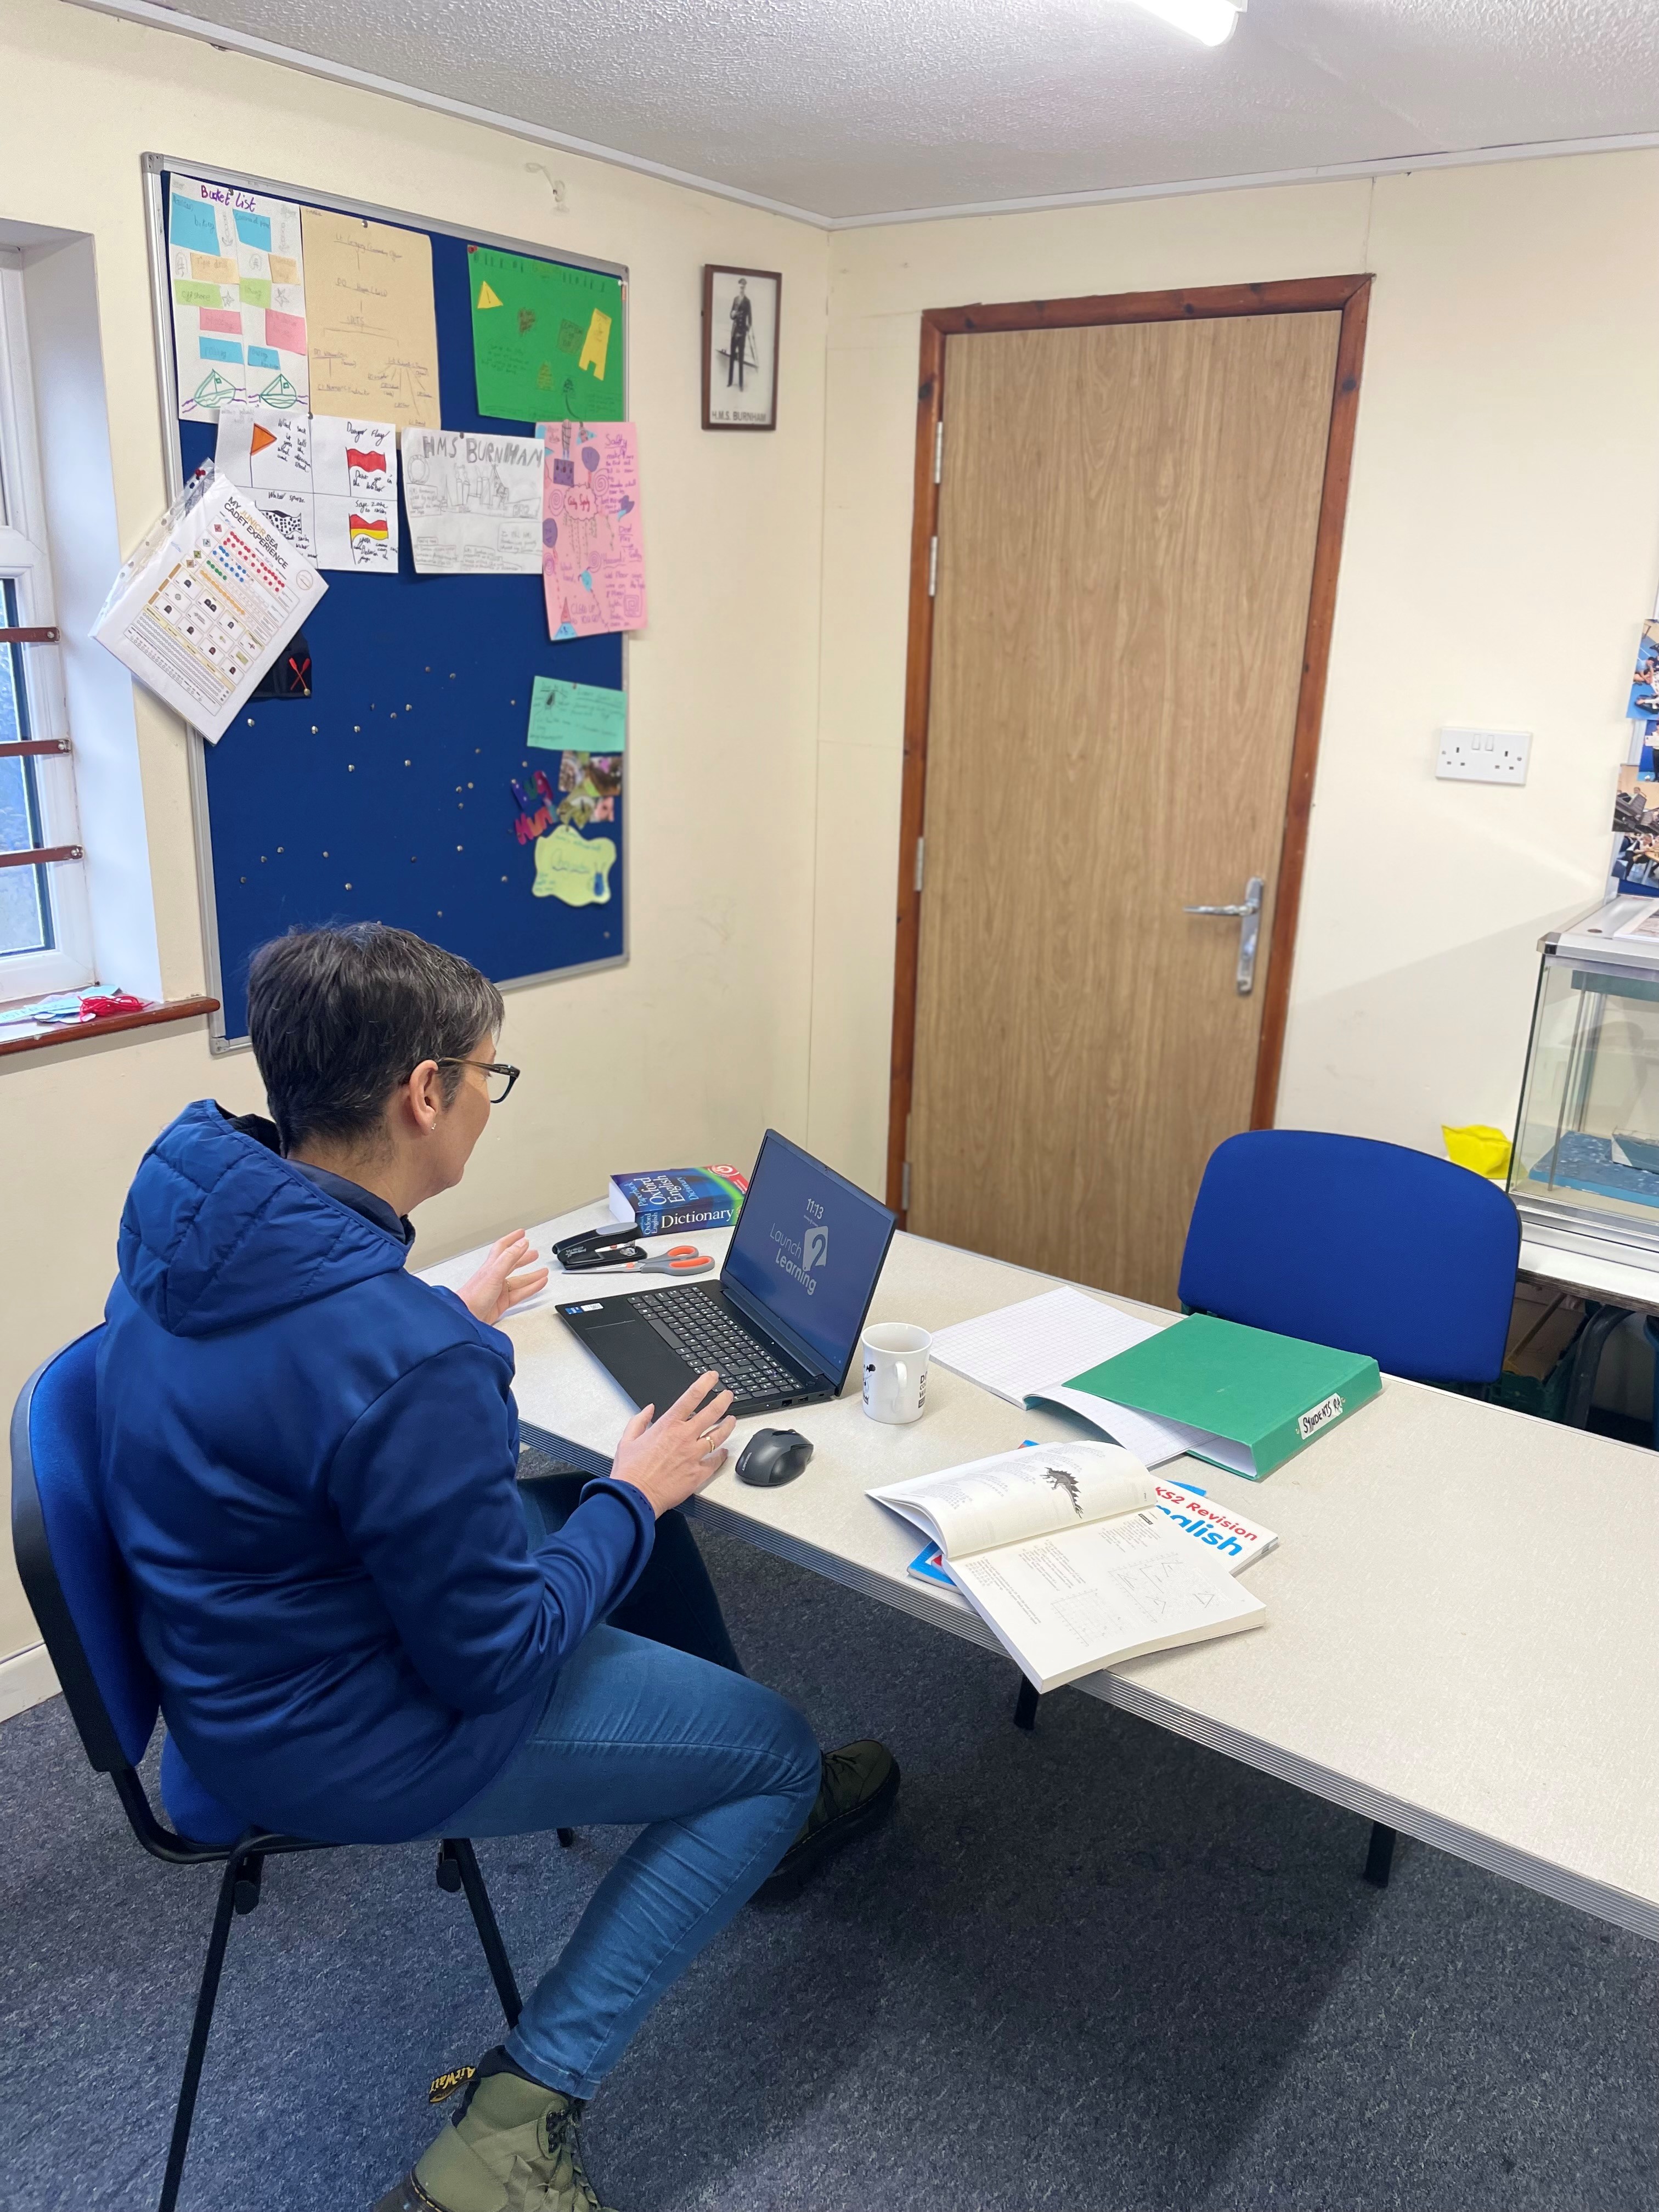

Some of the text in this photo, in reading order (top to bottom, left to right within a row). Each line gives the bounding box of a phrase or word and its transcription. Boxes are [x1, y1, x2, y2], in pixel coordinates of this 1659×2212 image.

[733, 411, 766, 422] BURNHAM
[224, 503, 248, 526] CADET
[246, 525, 289, 569] EXPERIENCE
[228, 496, 278, 550] MY JUNIOR SEA
[624, 1182, 648, 1206] Paperback
[634, 1177, 667, 1205] Oxford
[654, 1175, 686, 1203] English
[677, 1177, 699, 1200] Dictionary
[651, 1212, 660, 1234] English
[661, 1209, 735, 1228] Dictionary
[806, 1198, 824, 1220] 11:13
[770, 1222, 802, 1260] Launch
[775, 1248, 817, 1295] Learning
[1155, 1486, 1186, 1504] KS2
[1186, 1502, 1258, 1541] Revision
[1155, 1505, 1243, 1556] glish
